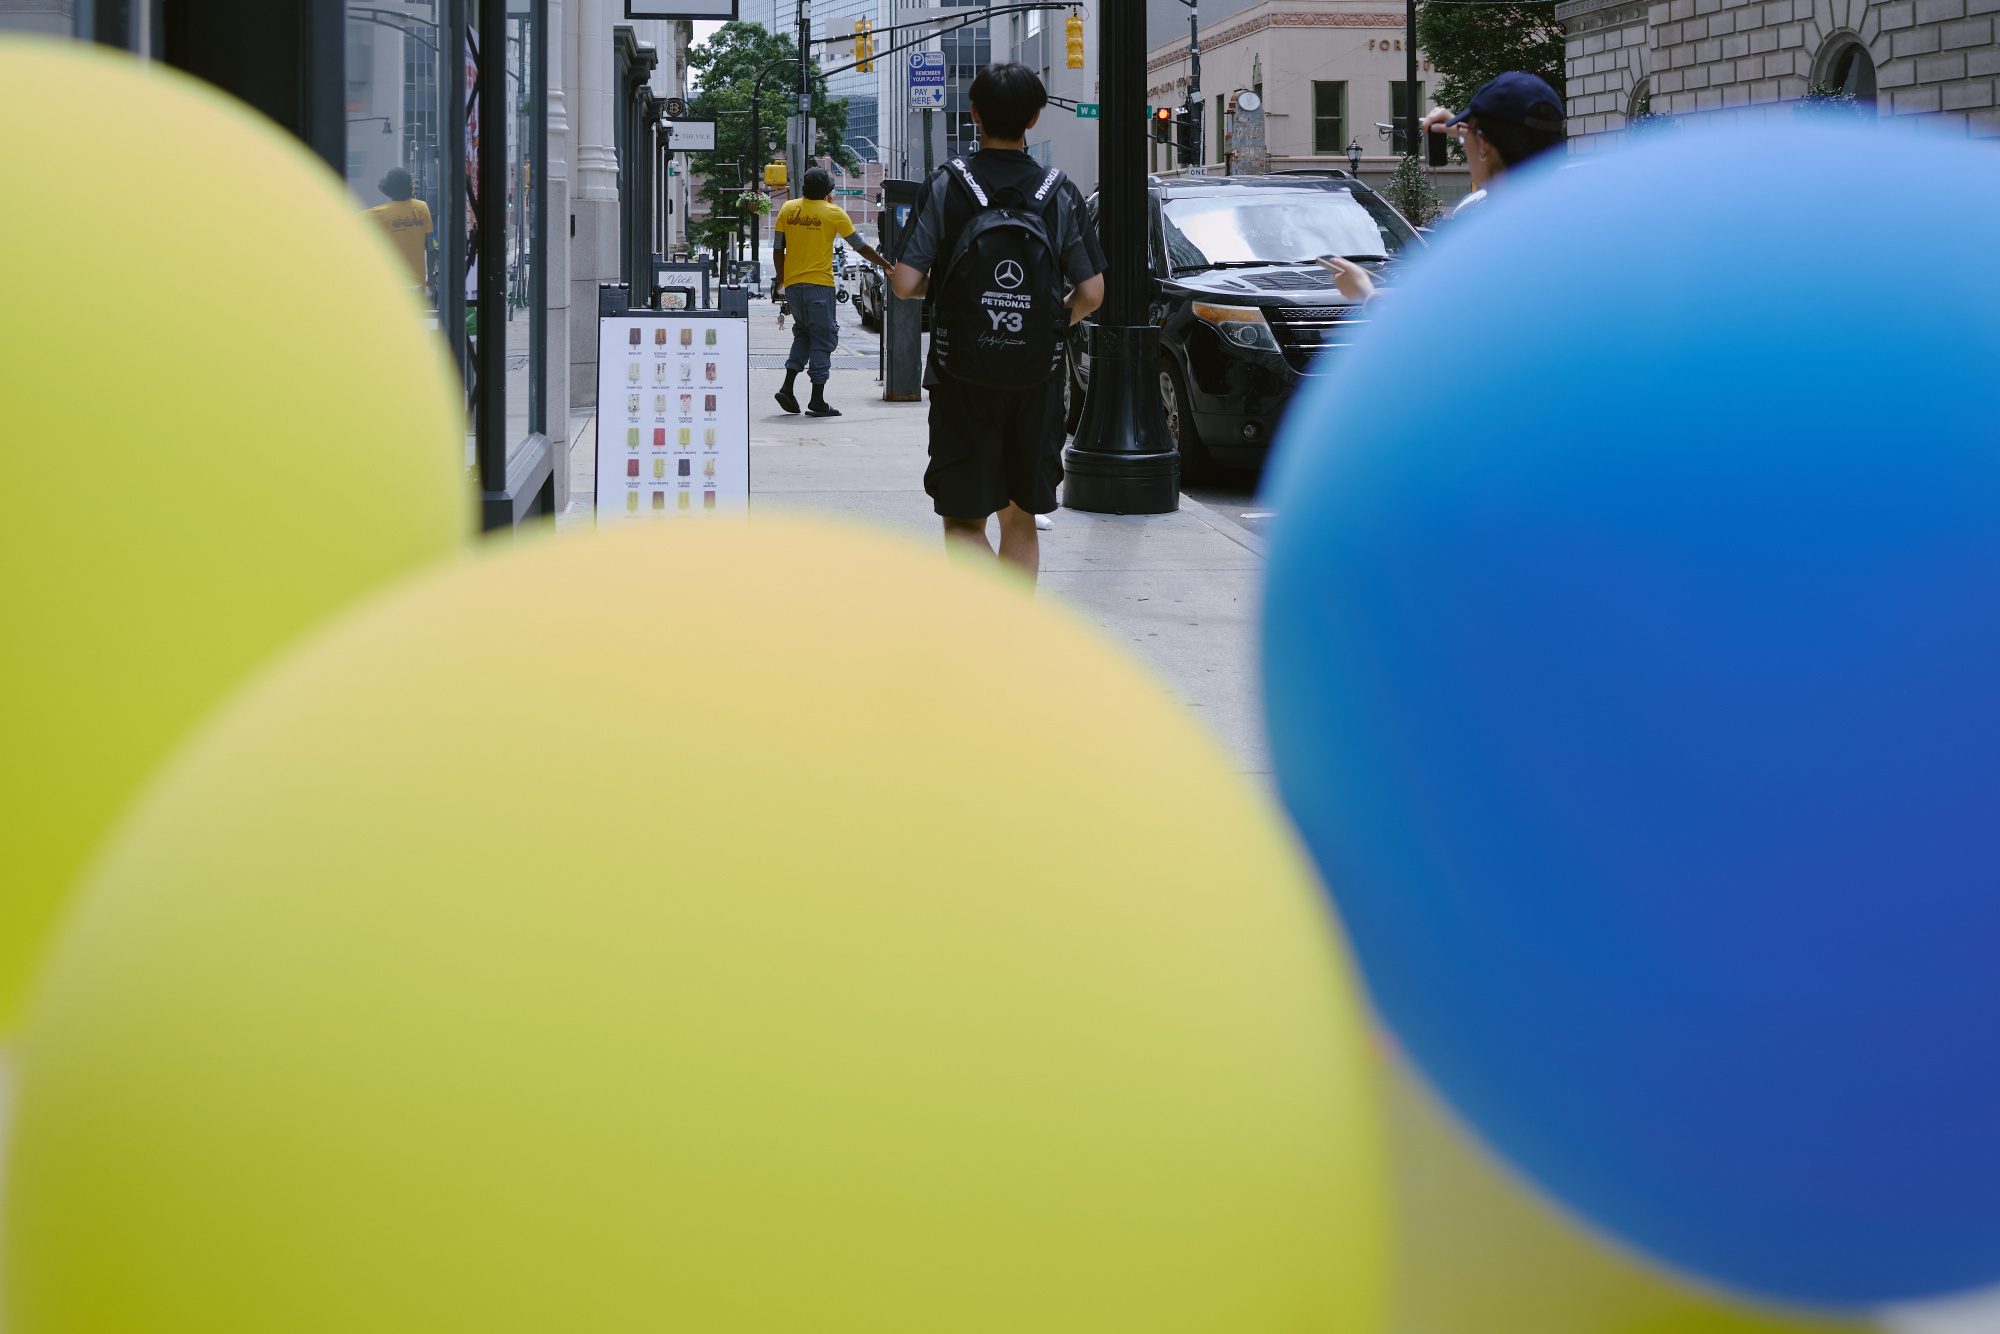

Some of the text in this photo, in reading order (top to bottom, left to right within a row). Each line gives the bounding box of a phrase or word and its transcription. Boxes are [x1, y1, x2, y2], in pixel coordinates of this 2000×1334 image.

[914, 88, 928, 96] PAY
[912, 97, 931, 105] HERE
[1080, 107, 1097, 115] Wa
[1034, 167, 1060, 201] ETRONAS
[667, 274, 694, 285] Vick
[999, 292, 1031, 301] AMG
[981, 297, 1031, 309] PETRONAS
[987, 309, 1023, 333] Y-3
